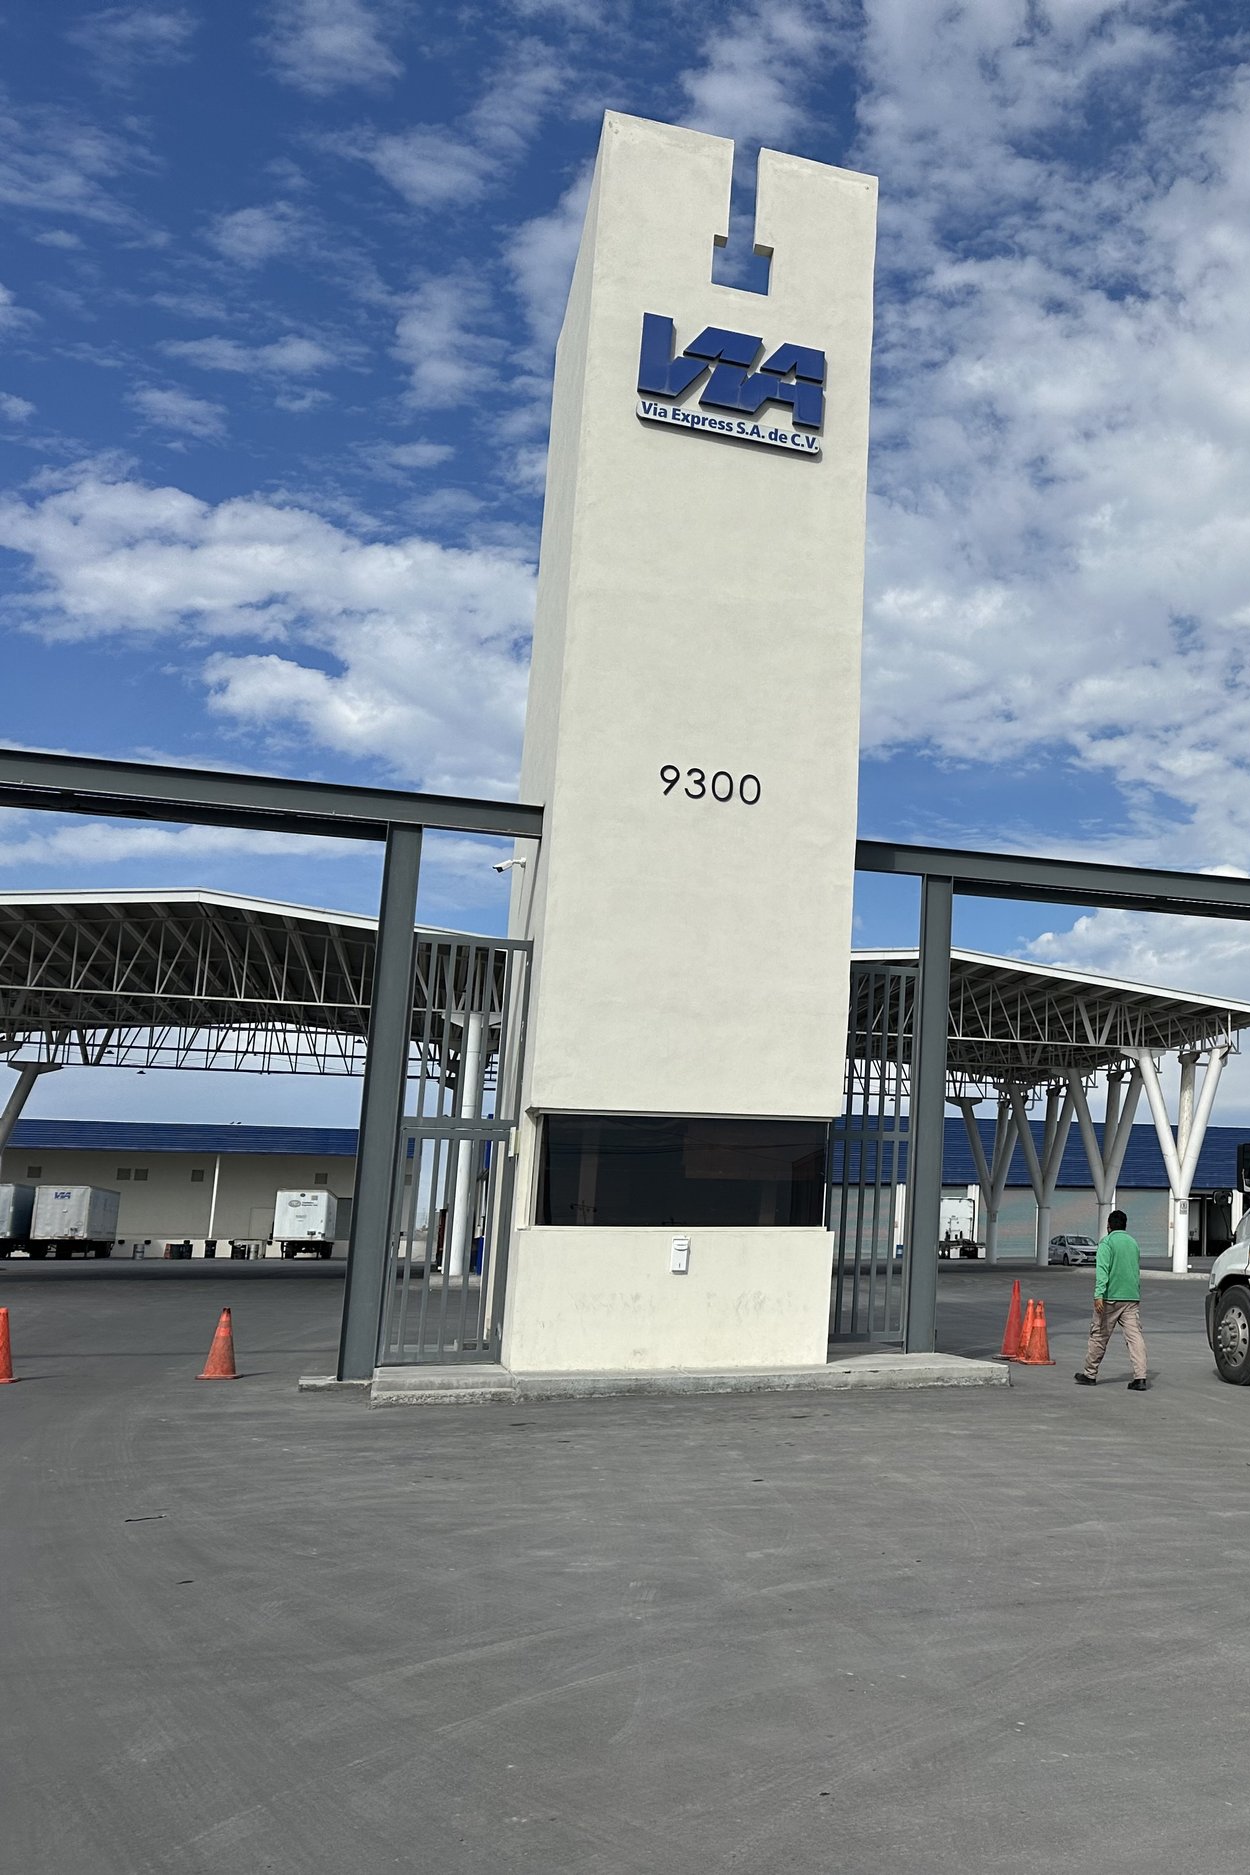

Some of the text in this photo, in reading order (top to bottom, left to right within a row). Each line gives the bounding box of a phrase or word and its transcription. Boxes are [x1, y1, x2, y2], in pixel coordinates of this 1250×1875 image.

[637, 312, 825, 429] VIA
[641, 401, 819, 451] Via Express S.A. de C.V.
[660, 765, 761, 805] 9300
